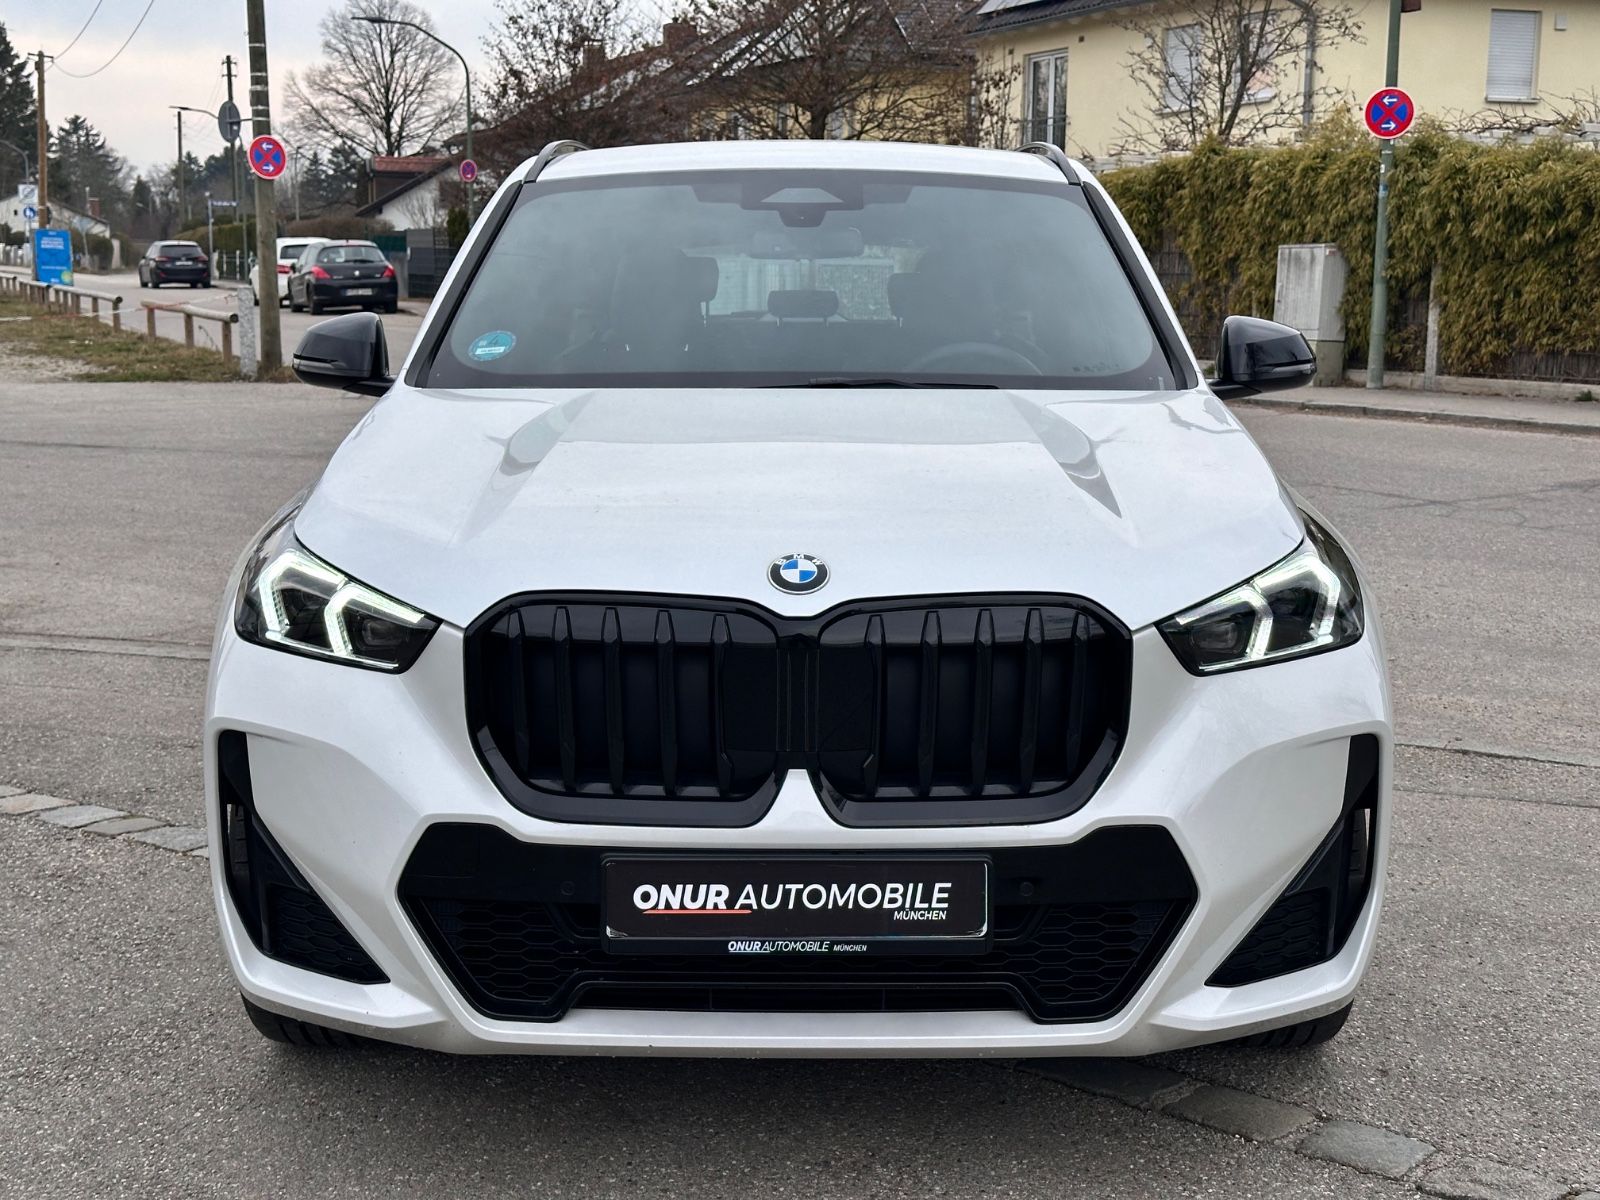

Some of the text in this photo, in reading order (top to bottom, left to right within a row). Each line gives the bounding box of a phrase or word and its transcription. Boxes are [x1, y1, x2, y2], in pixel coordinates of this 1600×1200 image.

[774, 553, 824, 565] BMW
[633, 882, 952, 910] ONUR AUTOMOBILE
[893, 908, 947, 921] MÜNCHEN
[727, 941, 868, 952] ONUR AUTOMOBILE MÜNCHEN
